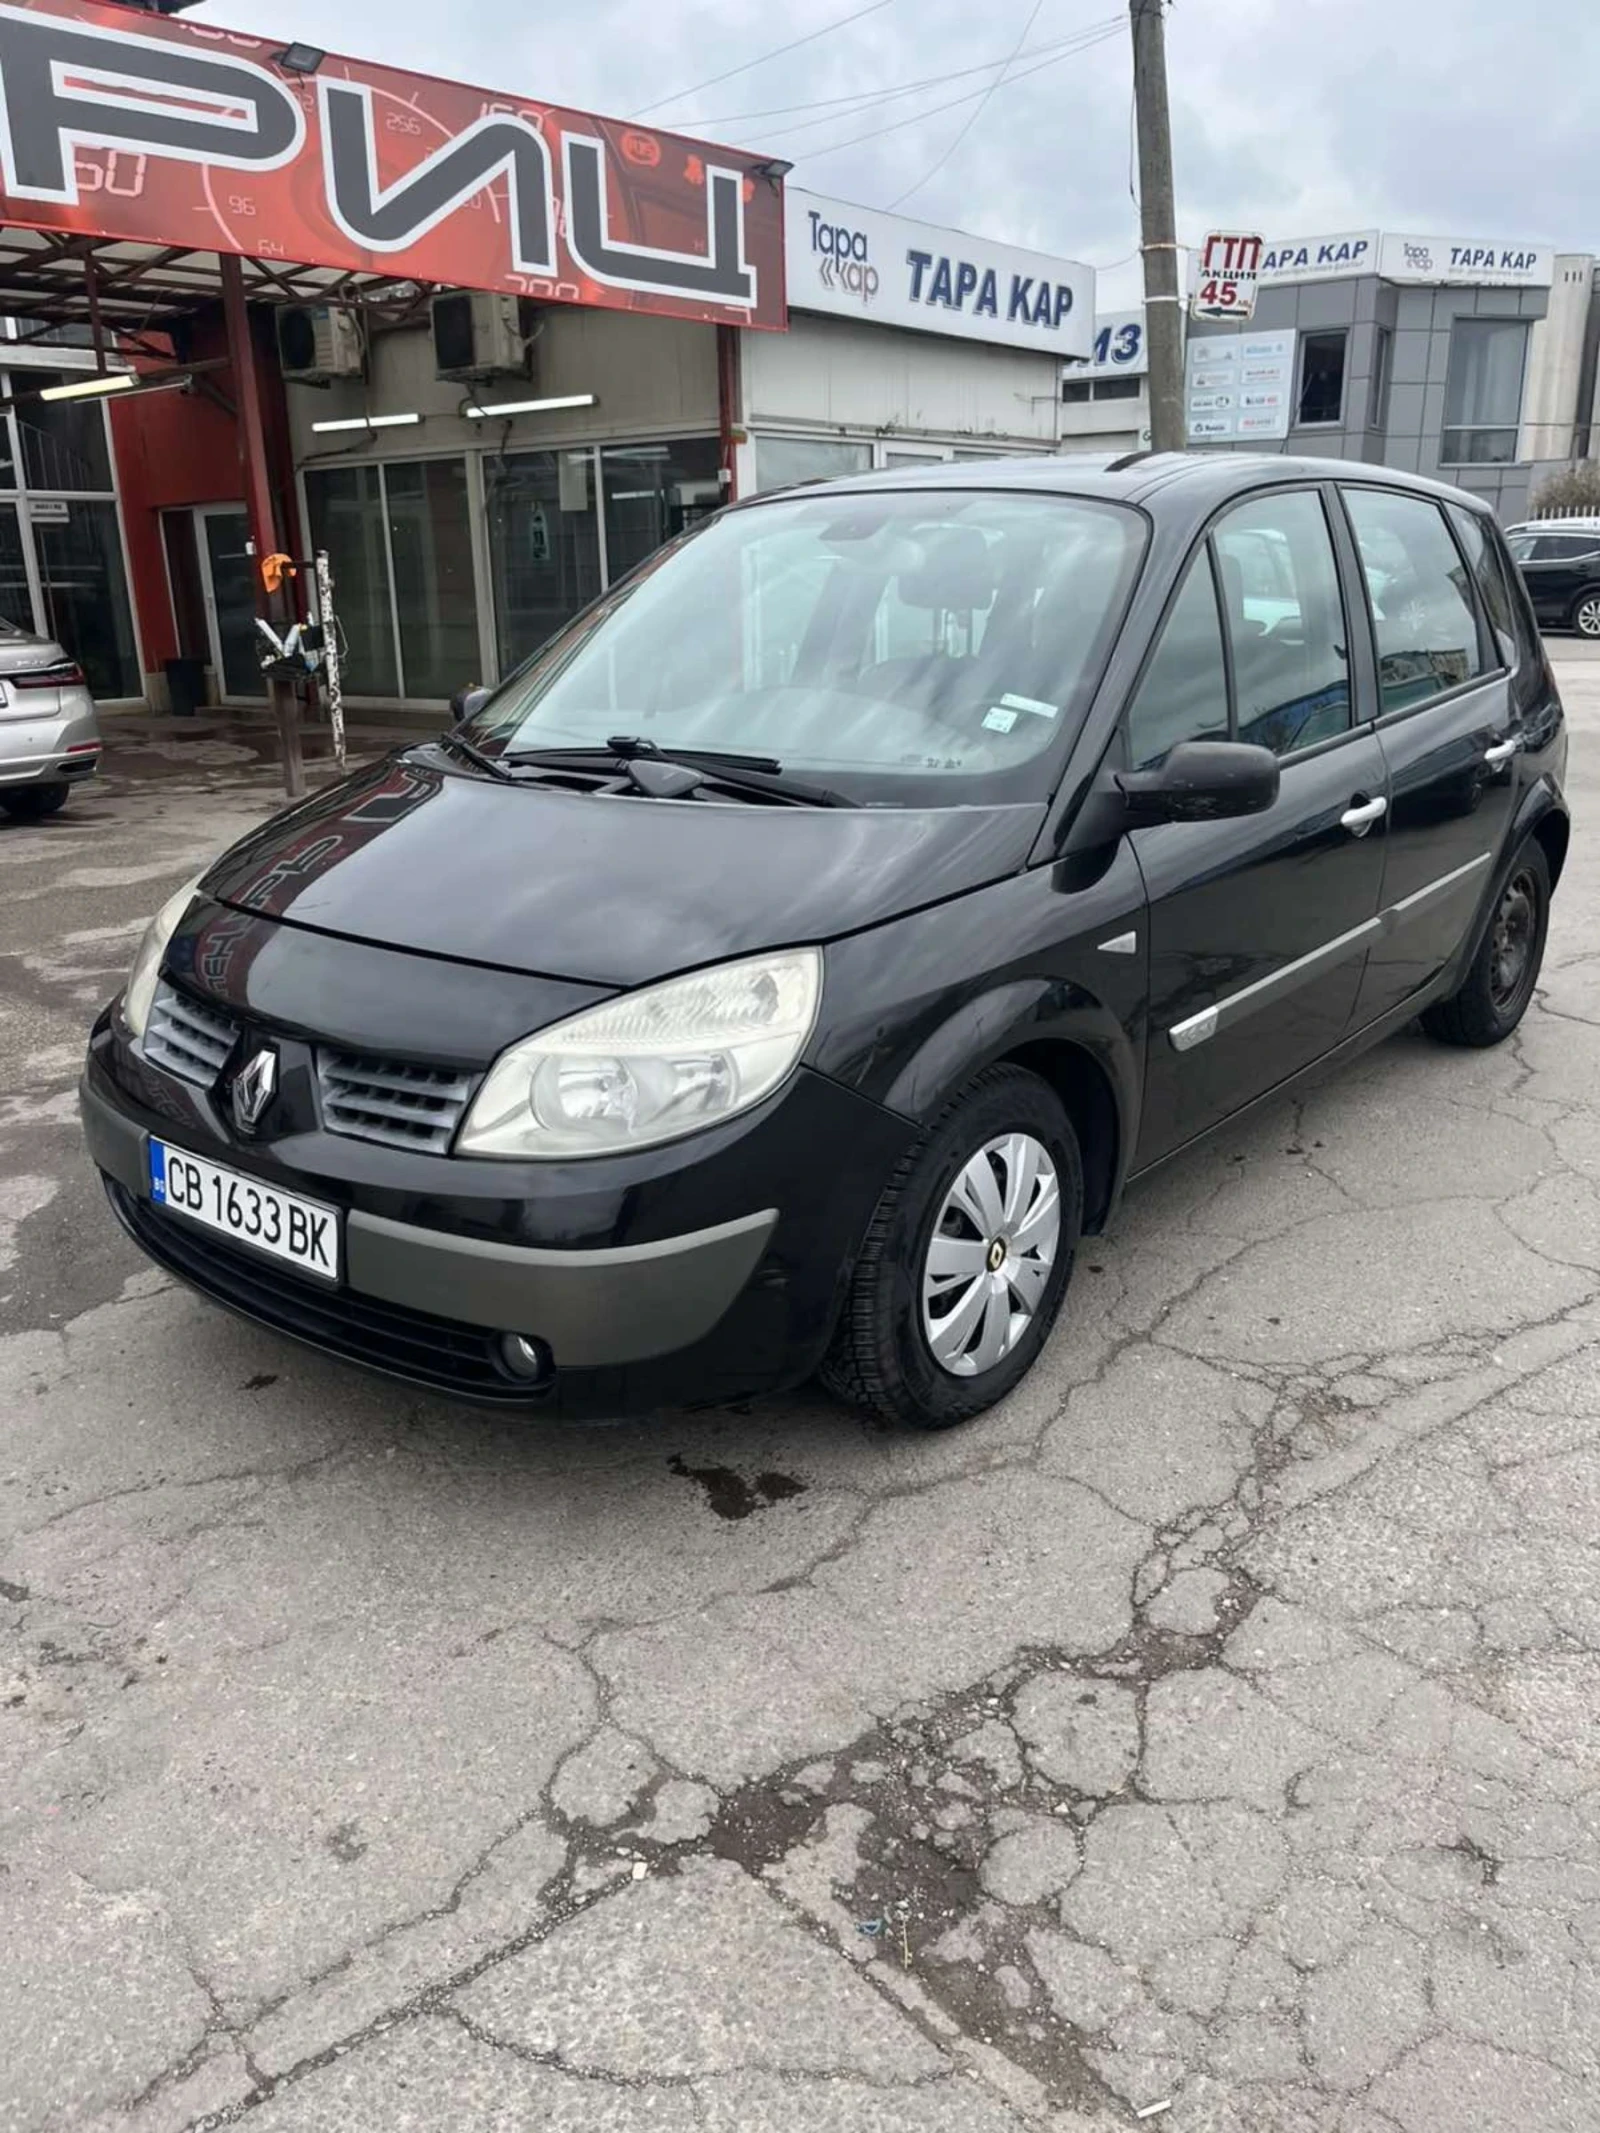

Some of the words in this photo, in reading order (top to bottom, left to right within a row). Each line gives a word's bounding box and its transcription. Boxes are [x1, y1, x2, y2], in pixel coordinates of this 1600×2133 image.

[228, 194, 257, 216] 96
[1203, 235, 1263, 270] ГТП
[1262, 251, 1308, 270] АРА
[1316, 240, 1368, 264] КАР
[1450, 247, 1495, 268] ТАРА
[1500, 250, 1537, 270] КАР
[1200, 269, 1257, 280] АКЦИЯ
[906, 249, 998, 318] ТАРА
[1007, 274, 1074, 330] КАР
[1200, 279, 1238, 306] 45
[168, 1156, 203, 1211] CB
[212, 1174, 281, 1245] 1633
[289, 1203, 330, 1268] BK
